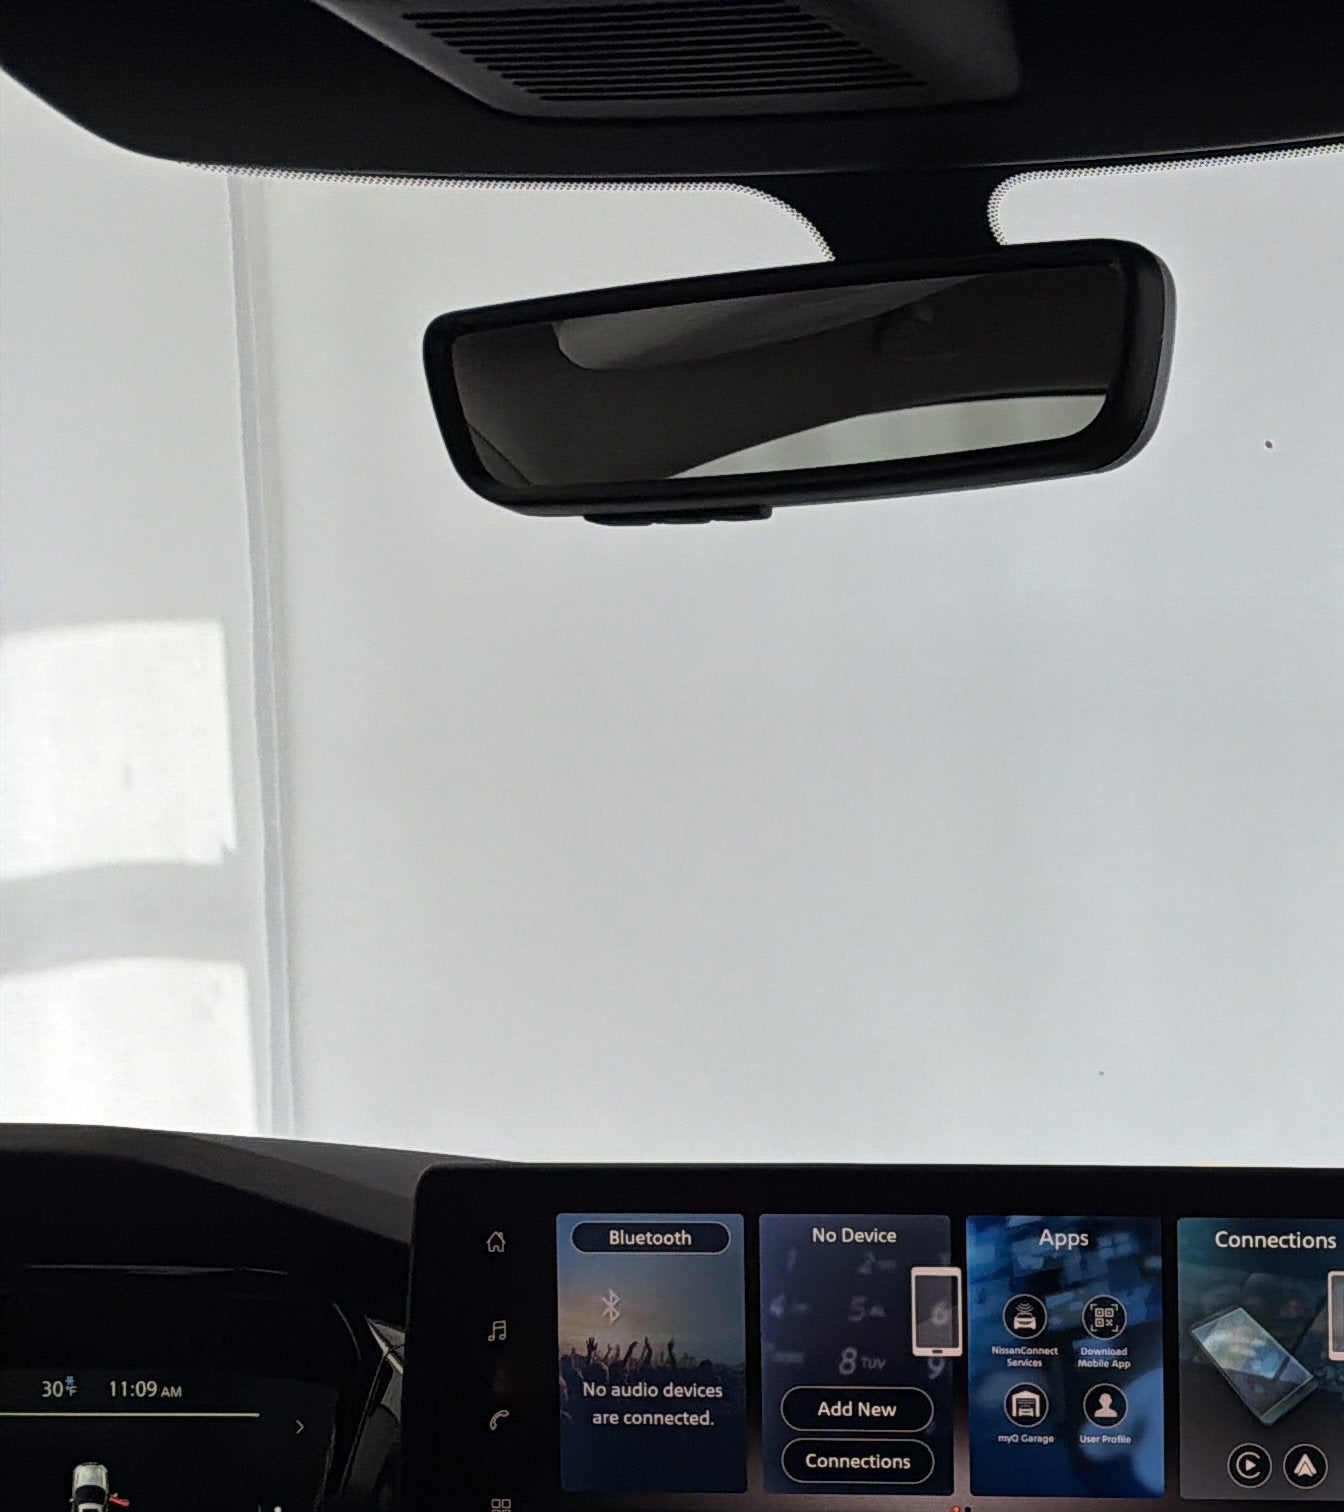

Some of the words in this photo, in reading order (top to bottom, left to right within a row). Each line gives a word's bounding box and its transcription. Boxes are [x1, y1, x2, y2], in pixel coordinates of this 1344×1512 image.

[609, 1230, 692, 1246] Bluetooth
[812, 1228, 837, 1243] No
[841, 1227, 897, 1243] Device
[1039, 1228, 1089, 1250] Apps
[1215, 1231, 1337, 1250] Connections
[991, 1346, 1059, 1356] NissanConnect
[1080, 1347, 1128, 1356] Download
[838, 1347, 858, 1375] 8
[1007, 1358, 1043, 1368] Services
[1077, 1359, 1109, 1368] Mobile
[1111, 1359, 1131, 1370] App
[109, 1380, 158, 1398] 11:09
[160, 1385, 183, 1398] AM
[583, 1383, 607, 1397] No
[611, 1382, 659, 1398] audio
[663, 1381, 723, 1398] devices
[817, 1400, 853, 1417] Add
[858, 1401, 897, 1417] New
[592, 1413, 619, 1425] are
[623, 1410, 715, 1426] connected.
[1021, 1435, 1054, 1445] Garage
[1079, 1435, 1099, 1444] User
[1102, 1434, 1132, 1444] Profile
[805, 1453, 911, 1469] Connections
